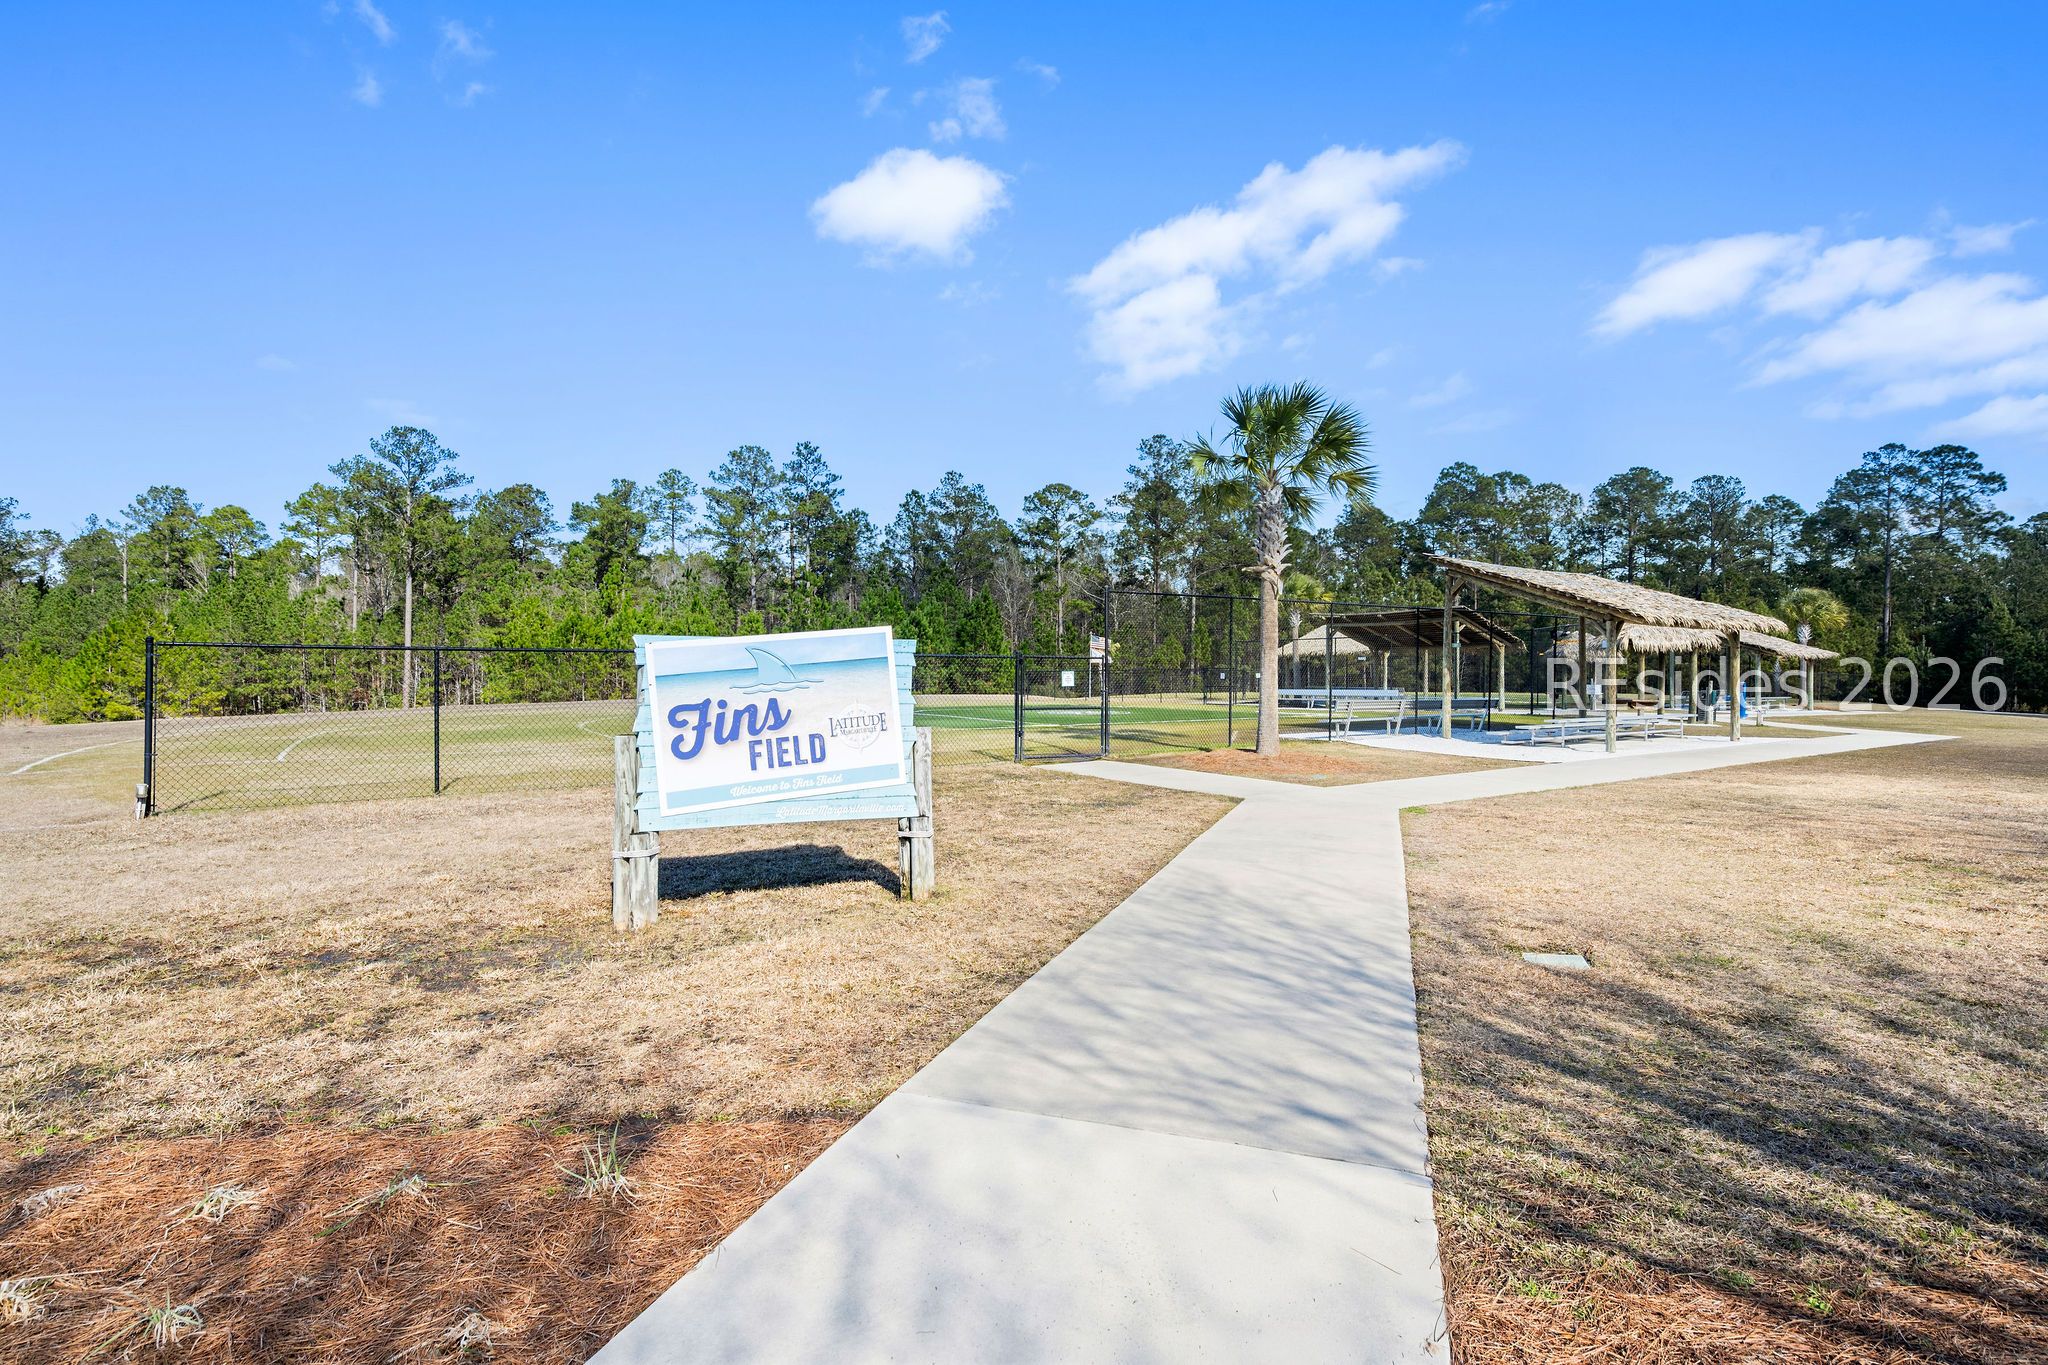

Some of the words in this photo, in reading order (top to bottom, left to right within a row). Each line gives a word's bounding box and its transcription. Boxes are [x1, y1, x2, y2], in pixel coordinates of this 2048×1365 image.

[667, 698, 792, 760] Fins
[827, 712, 888, 737] LATITUDE
[748, 733, 827, 771] FIELD
[730, 783, 779, 798] Welcome
[780, 780, 791, 791] to
[792, 777, 816, 790] Fins
[816, 774, 844, 787] Field
